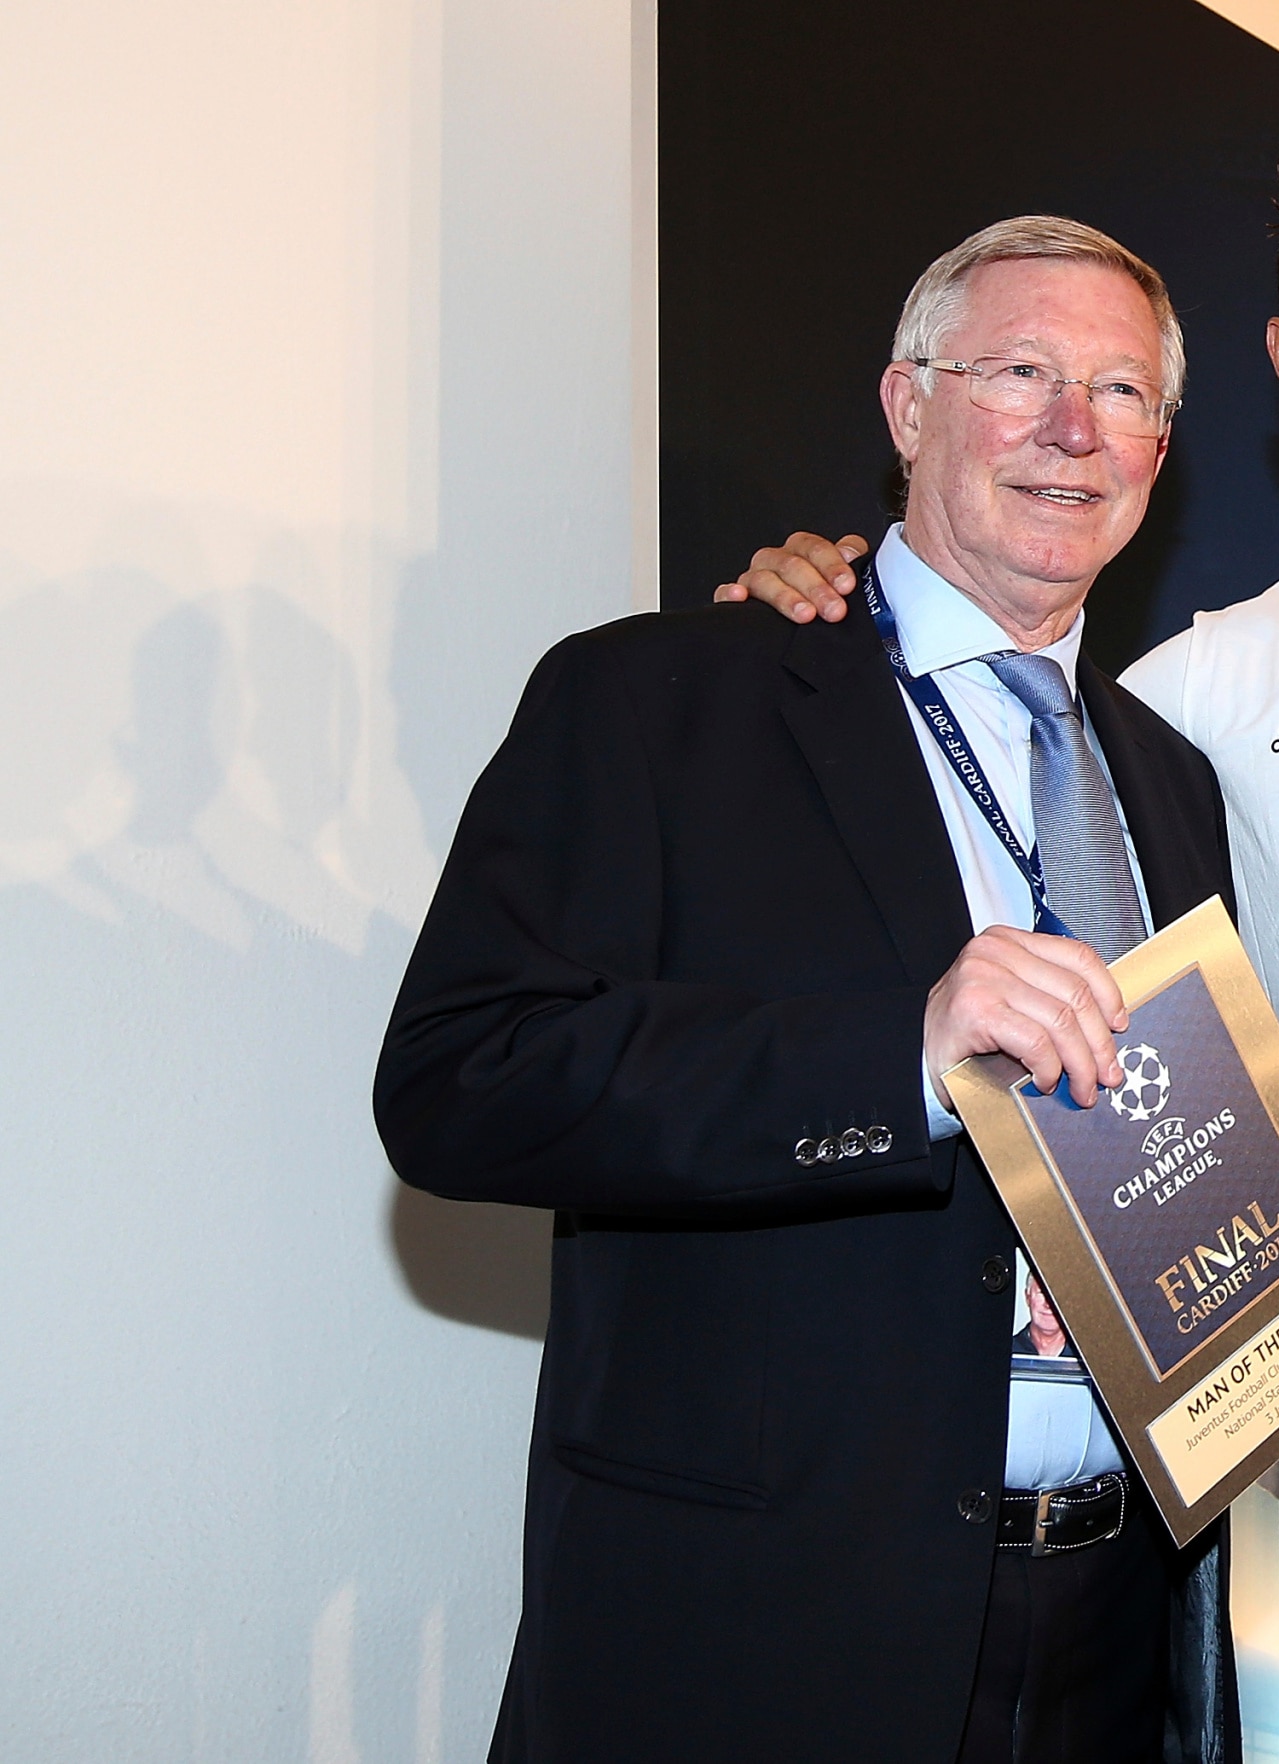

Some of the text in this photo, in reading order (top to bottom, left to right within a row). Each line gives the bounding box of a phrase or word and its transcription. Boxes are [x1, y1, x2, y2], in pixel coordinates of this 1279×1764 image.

[1113, 1107, 1237, 1209] CHAMPIONS
[1144, 1121, 1185, 1156] UEFA
[1185, 1407, 1230, 1451] Juventus
[1228, 1371, 1268, 1413] Football
[1186, 1377, 1230, 1422] MAN
[1230, 1355, 1254, 1384] OF
[1224, 1394, 1267, 1439] National
[1265, 1413, 1274, 1425] 3
